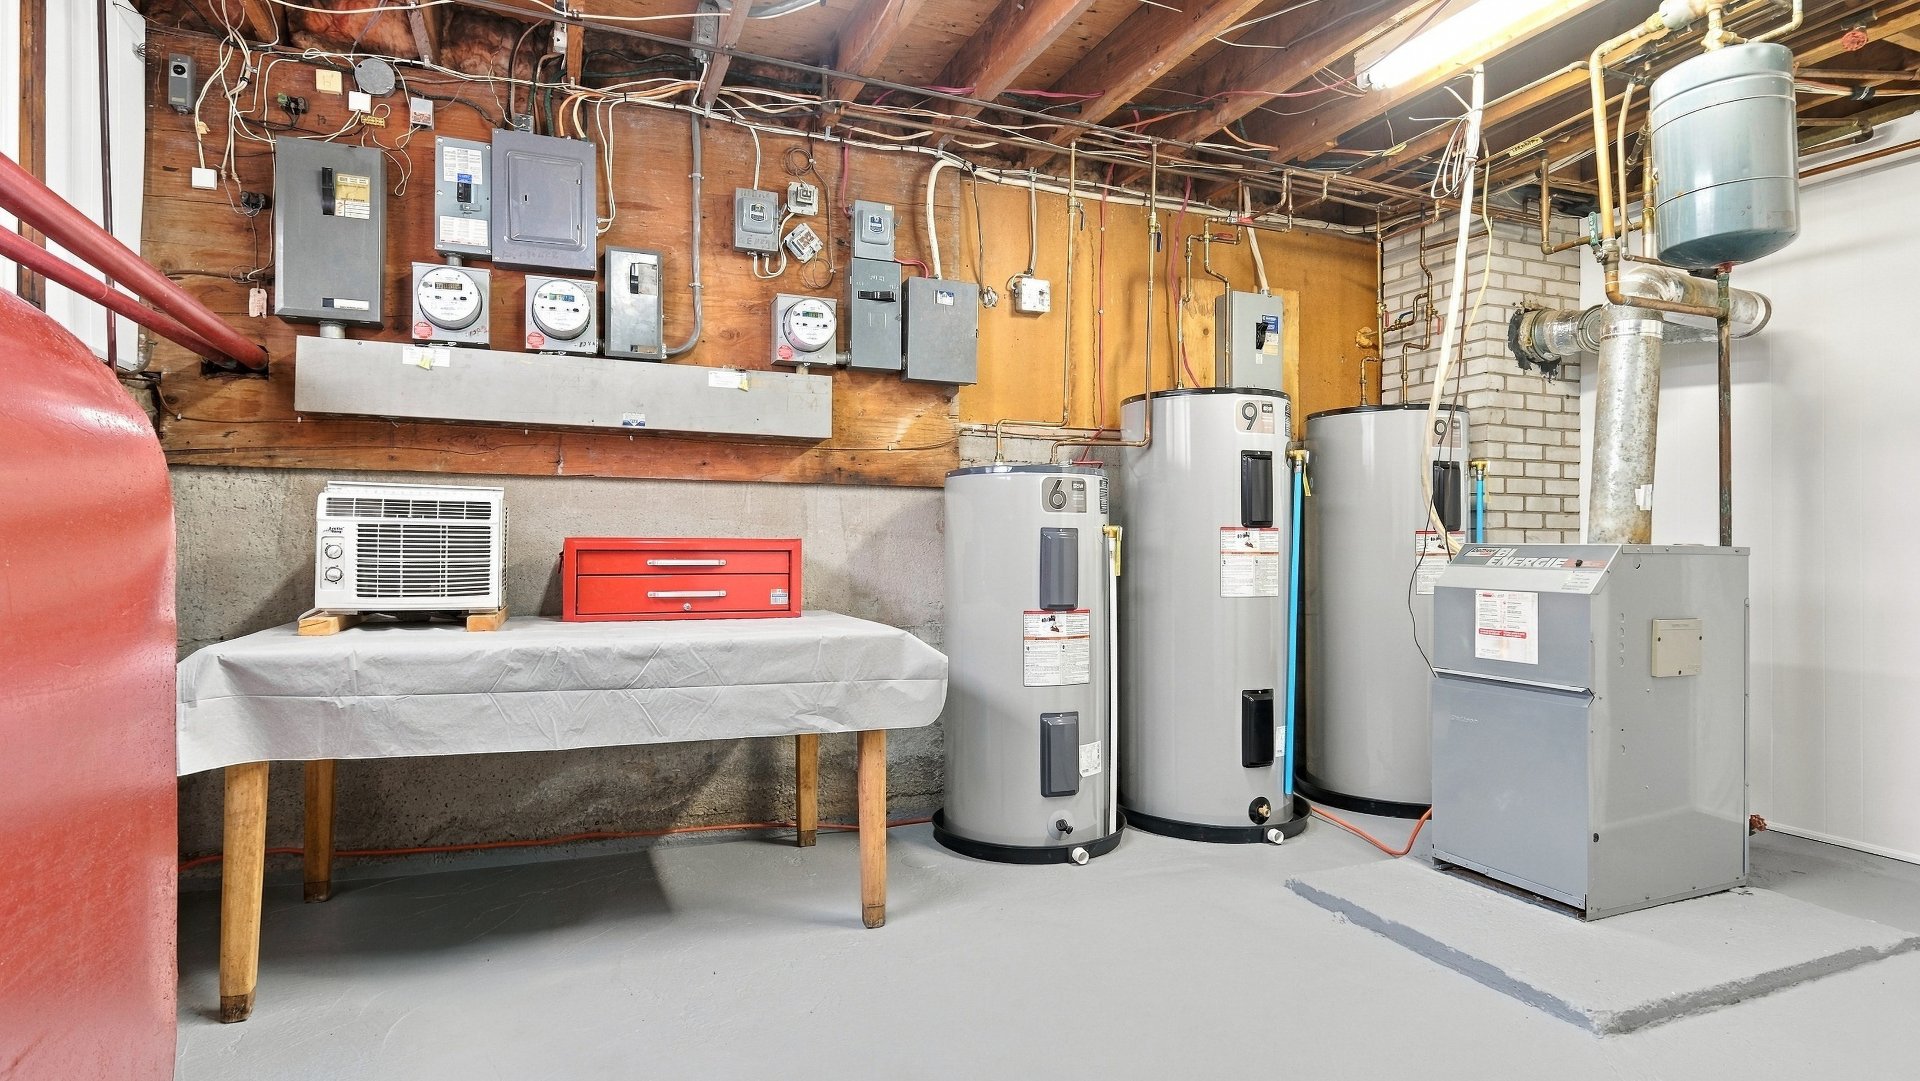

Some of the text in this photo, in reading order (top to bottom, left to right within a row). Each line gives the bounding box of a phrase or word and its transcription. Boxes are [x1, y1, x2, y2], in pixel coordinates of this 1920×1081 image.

[1241, 402, 1258, 430] 9
[1434, 419, 1447, 445] 9
[1048, 479, 1067, 510] 6
[1485, 557, 1570, 568] ENERGIE
